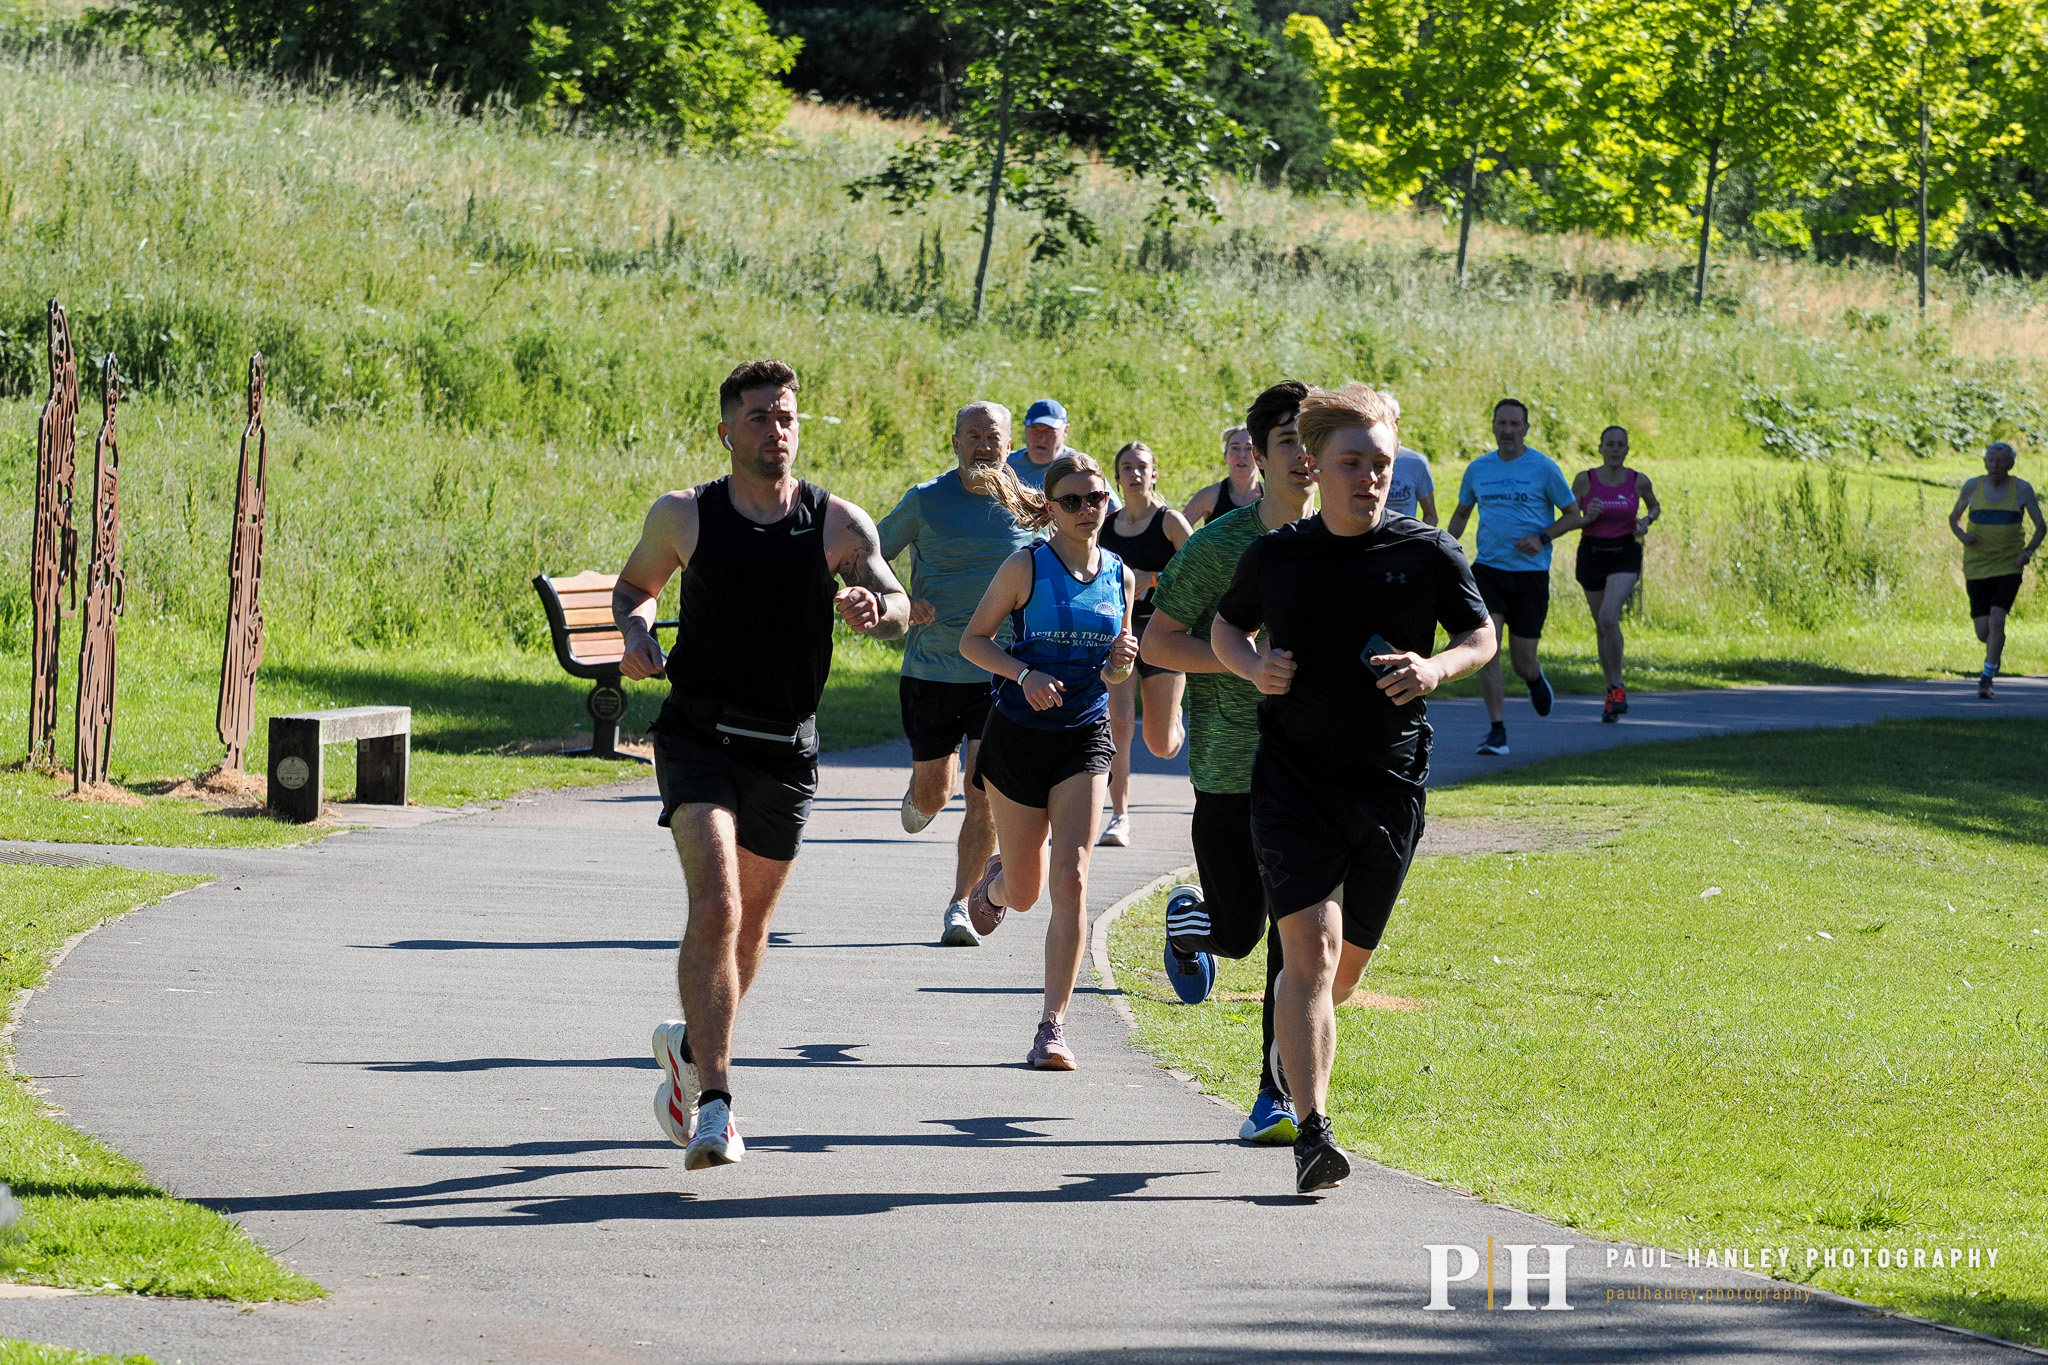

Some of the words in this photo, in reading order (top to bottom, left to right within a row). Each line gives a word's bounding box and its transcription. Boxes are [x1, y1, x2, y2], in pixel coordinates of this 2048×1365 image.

[1514, 492, 1528, 502] 20
[1069, 631, 1078, 639] &
[1081, 631, 1117, 642] TYLDES
